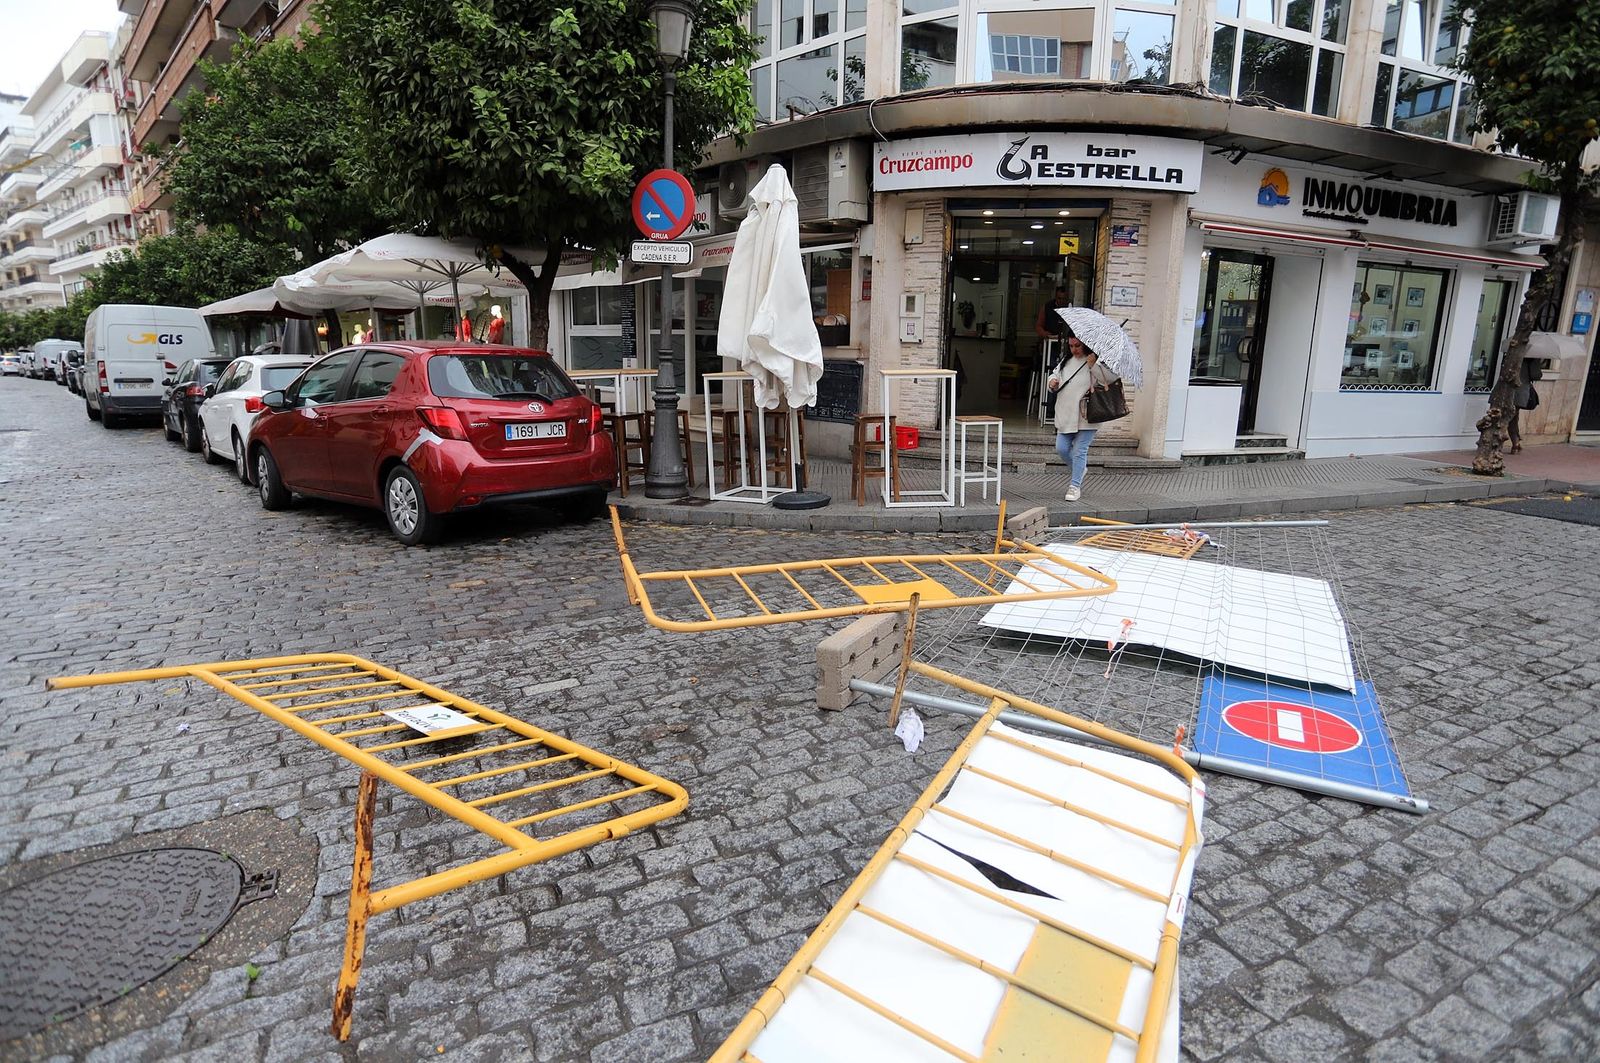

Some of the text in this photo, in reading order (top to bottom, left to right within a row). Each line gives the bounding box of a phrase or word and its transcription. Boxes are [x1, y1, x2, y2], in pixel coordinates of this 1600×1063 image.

[1087, 144, 1136, 158] bar
[880, 154, 973, 174] Cruzcampo
[1038, 162, 1183, 184] ESTRELLA
[1302, 177, 1458, 226] INMOUMBRIA
[633, 244, 688, 253] EXCEPTO VEHICULOS
[641, 253, 663, 261] CADENA
[158, 333, 183, 345] GLS
[515, 424, 564, 438] 1691 JCR
